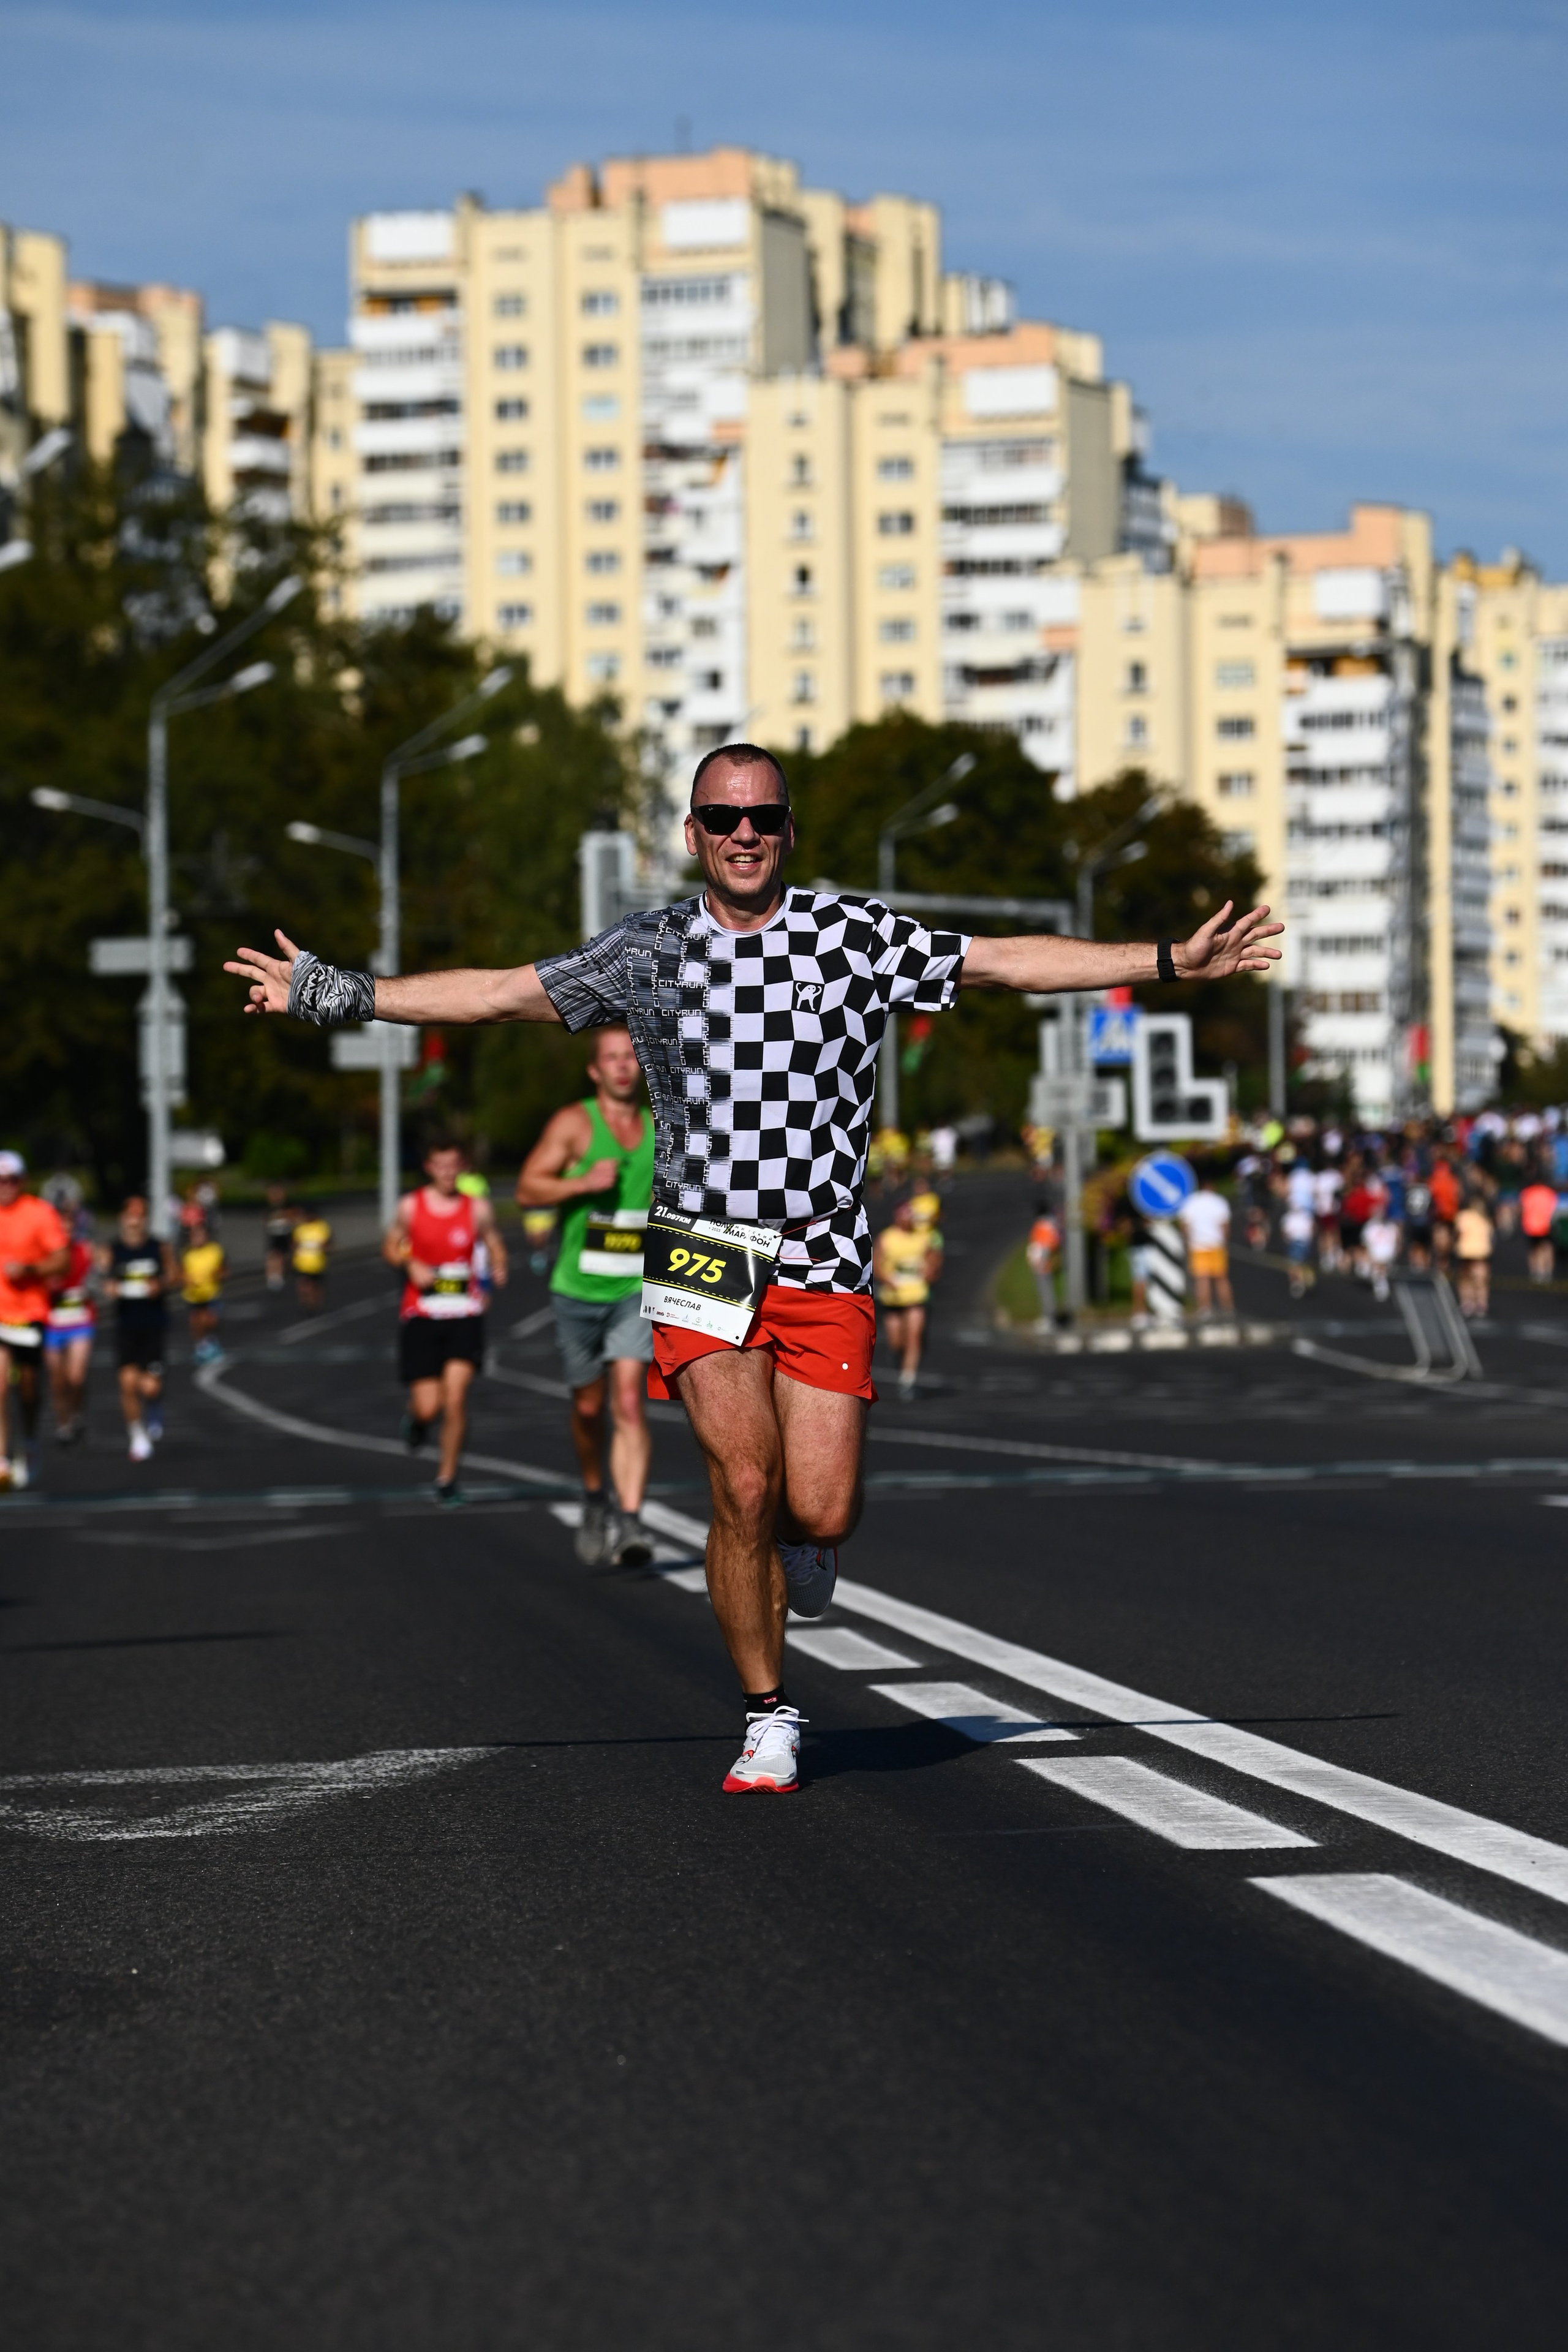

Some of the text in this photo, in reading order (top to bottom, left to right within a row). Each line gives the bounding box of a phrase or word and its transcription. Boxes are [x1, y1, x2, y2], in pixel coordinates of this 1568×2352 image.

[654, 914, 671, 951] CITYRUN
[665, 926, 706, 941] CITYRUN
[625, 946, 652, 957] YRUN
[626, 956, 639, 1006] CITYRUN
[651, 960, 660, 1008] CITYRUN
[658, 979, 703, 989] CITYRUN
[703, 966, 712, 1008] CITYRUN
[626, 1007, 655, 1016] CITYRUN
[677, 1017, 686, 1066] CITYRUN
[702, 1017, 710, 1066] CITYRUN
[673, 1096, 705, 1105] CITYRUN
[663, 1133, 674, 1178] CITYRUN
[703, 1136, 713, 1185] CITYRUN
[665, 1180, 701, 1192] CITYRUN
[667, 1248, 727, 1284] 975
[664, 1295, 702, 1311] ВЯЧЕСЛАВ
